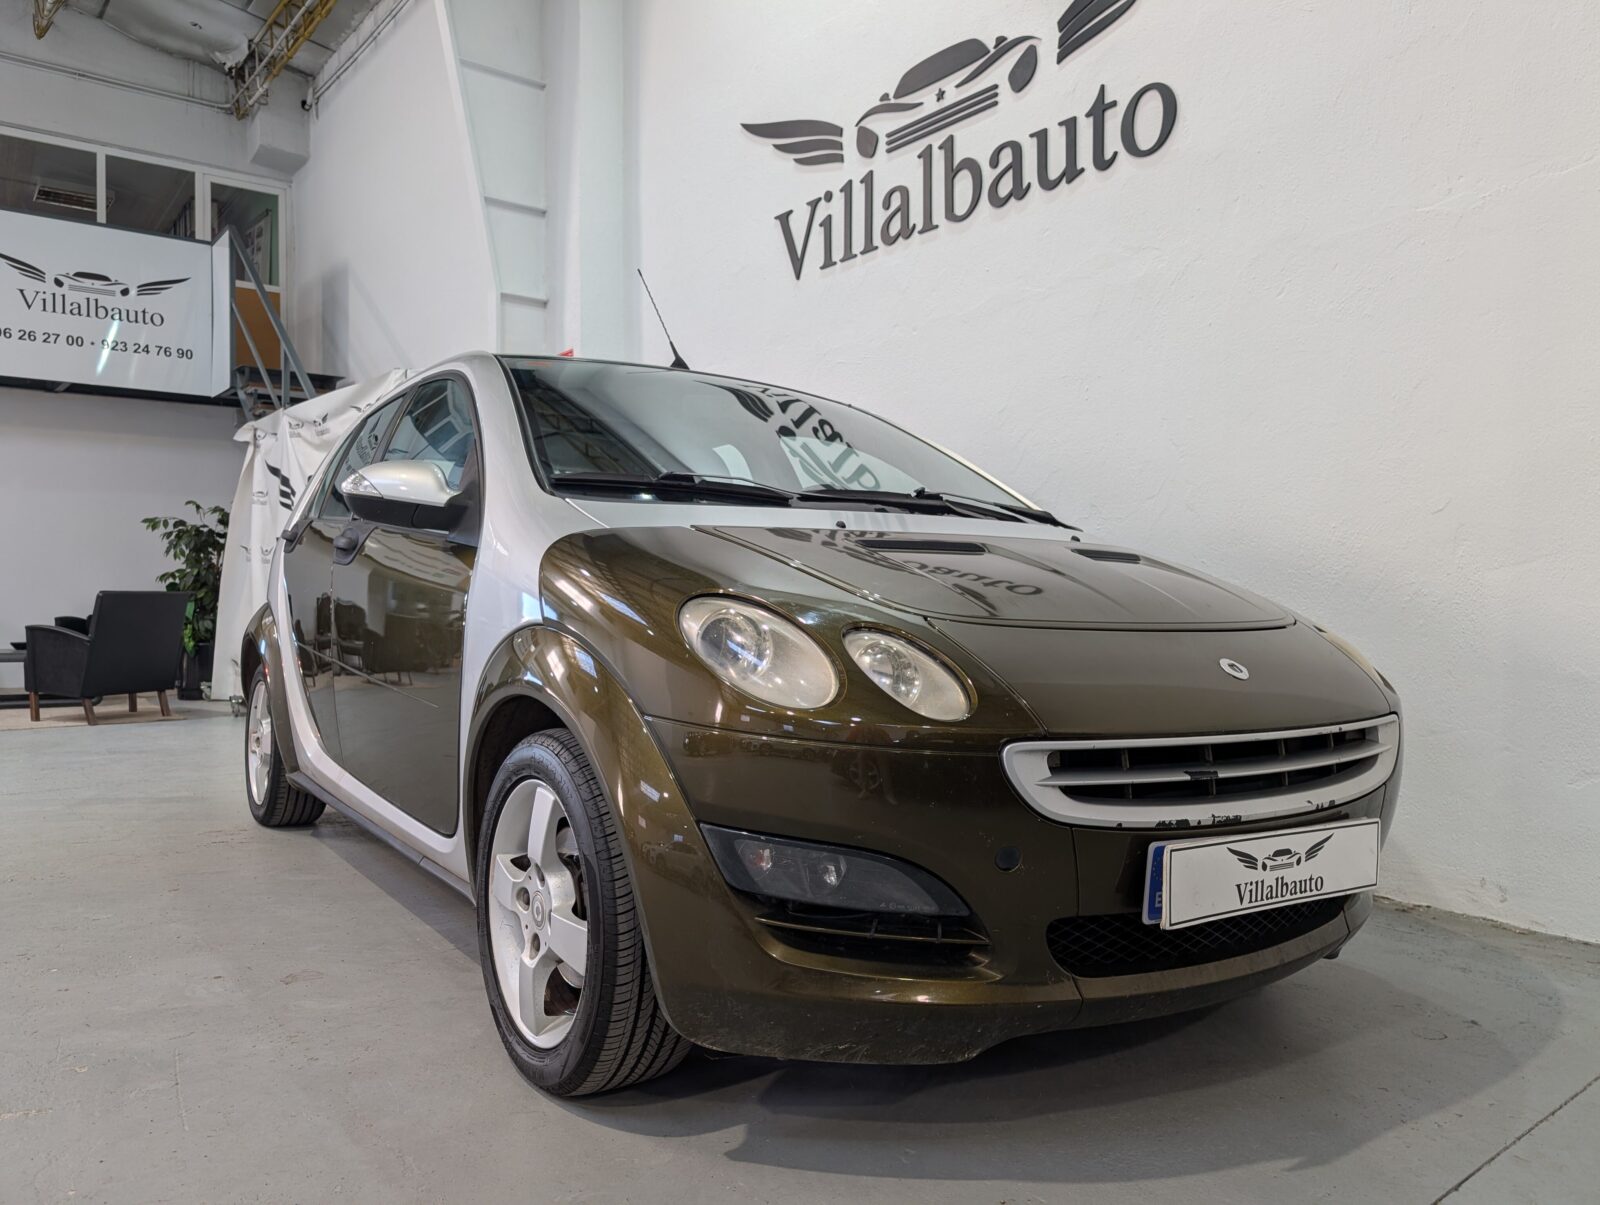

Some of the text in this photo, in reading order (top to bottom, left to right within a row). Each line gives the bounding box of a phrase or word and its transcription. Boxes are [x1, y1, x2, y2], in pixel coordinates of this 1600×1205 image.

[773, 81, 1178, 281] Villalbauto
[17, 288, 165, 327] Villalbauto
[0, 327, 193, 360] 6 26 27 00 923 24 76 90
[1235, 874, 1324, 906] Villalbauto
